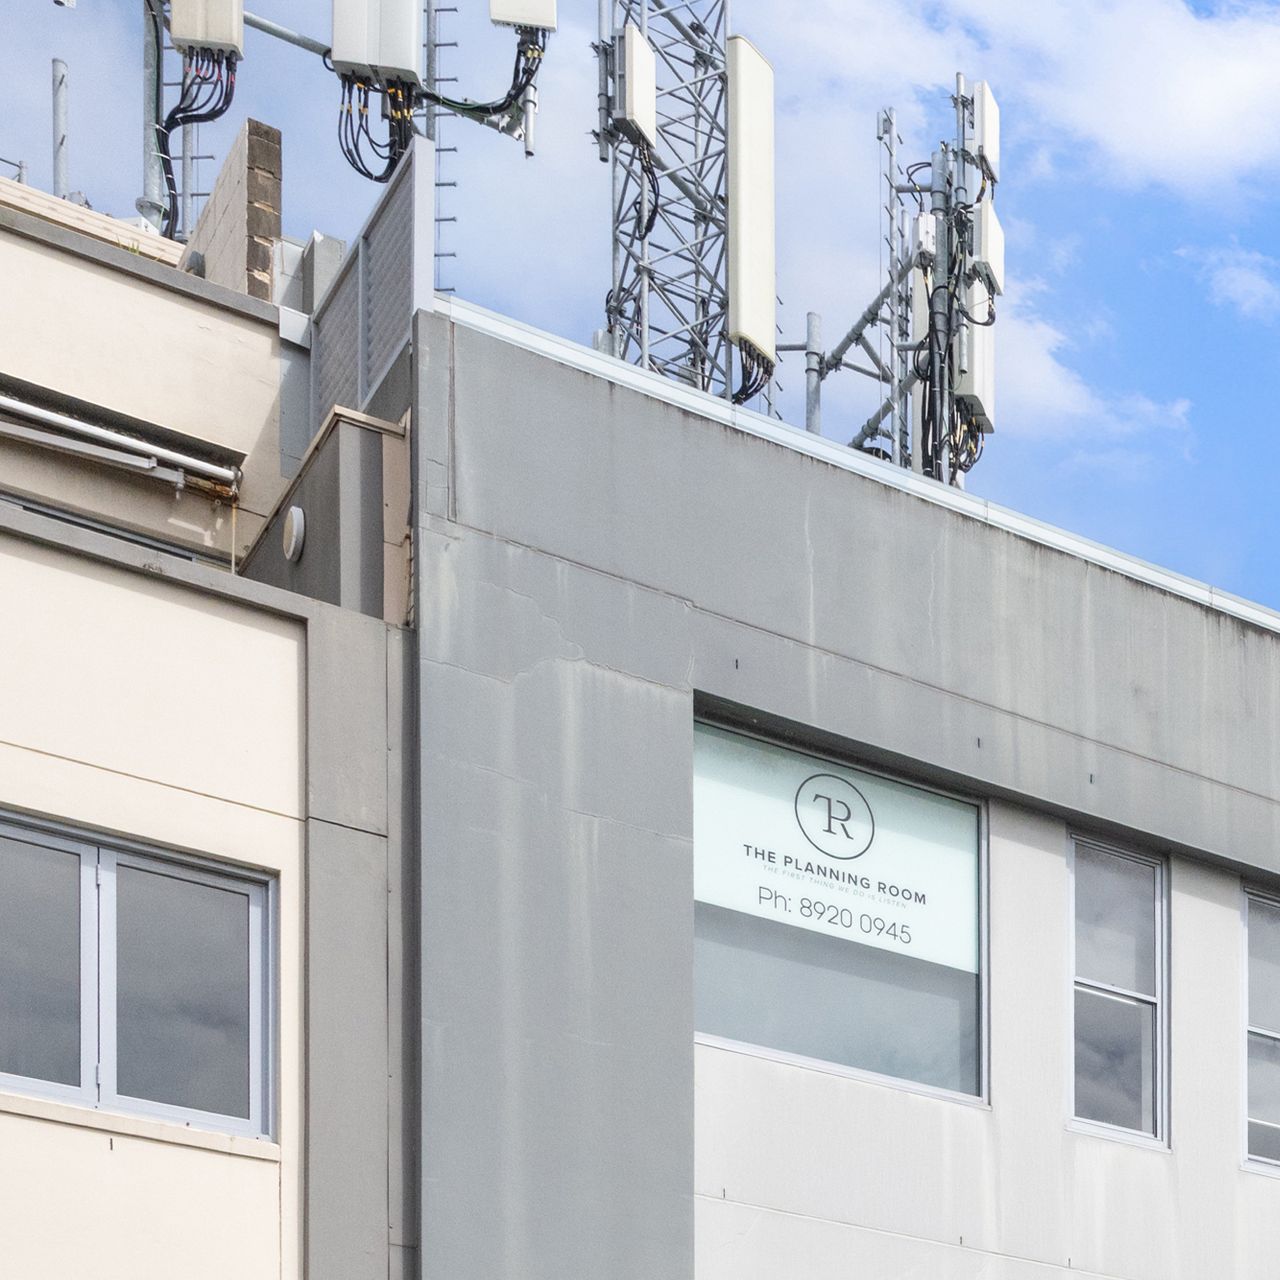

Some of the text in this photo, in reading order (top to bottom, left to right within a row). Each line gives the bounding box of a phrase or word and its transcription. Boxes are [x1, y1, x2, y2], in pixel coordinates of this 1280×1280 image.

[743, 844, 927, 905] THE PLANNING ROOM
[763, 864, 779, 875] THE
[781, 869, 806, 882] FIRST
[808, 876, 835, 891] THING
[758, 886, 912, 944] Ph: 8920 0945
